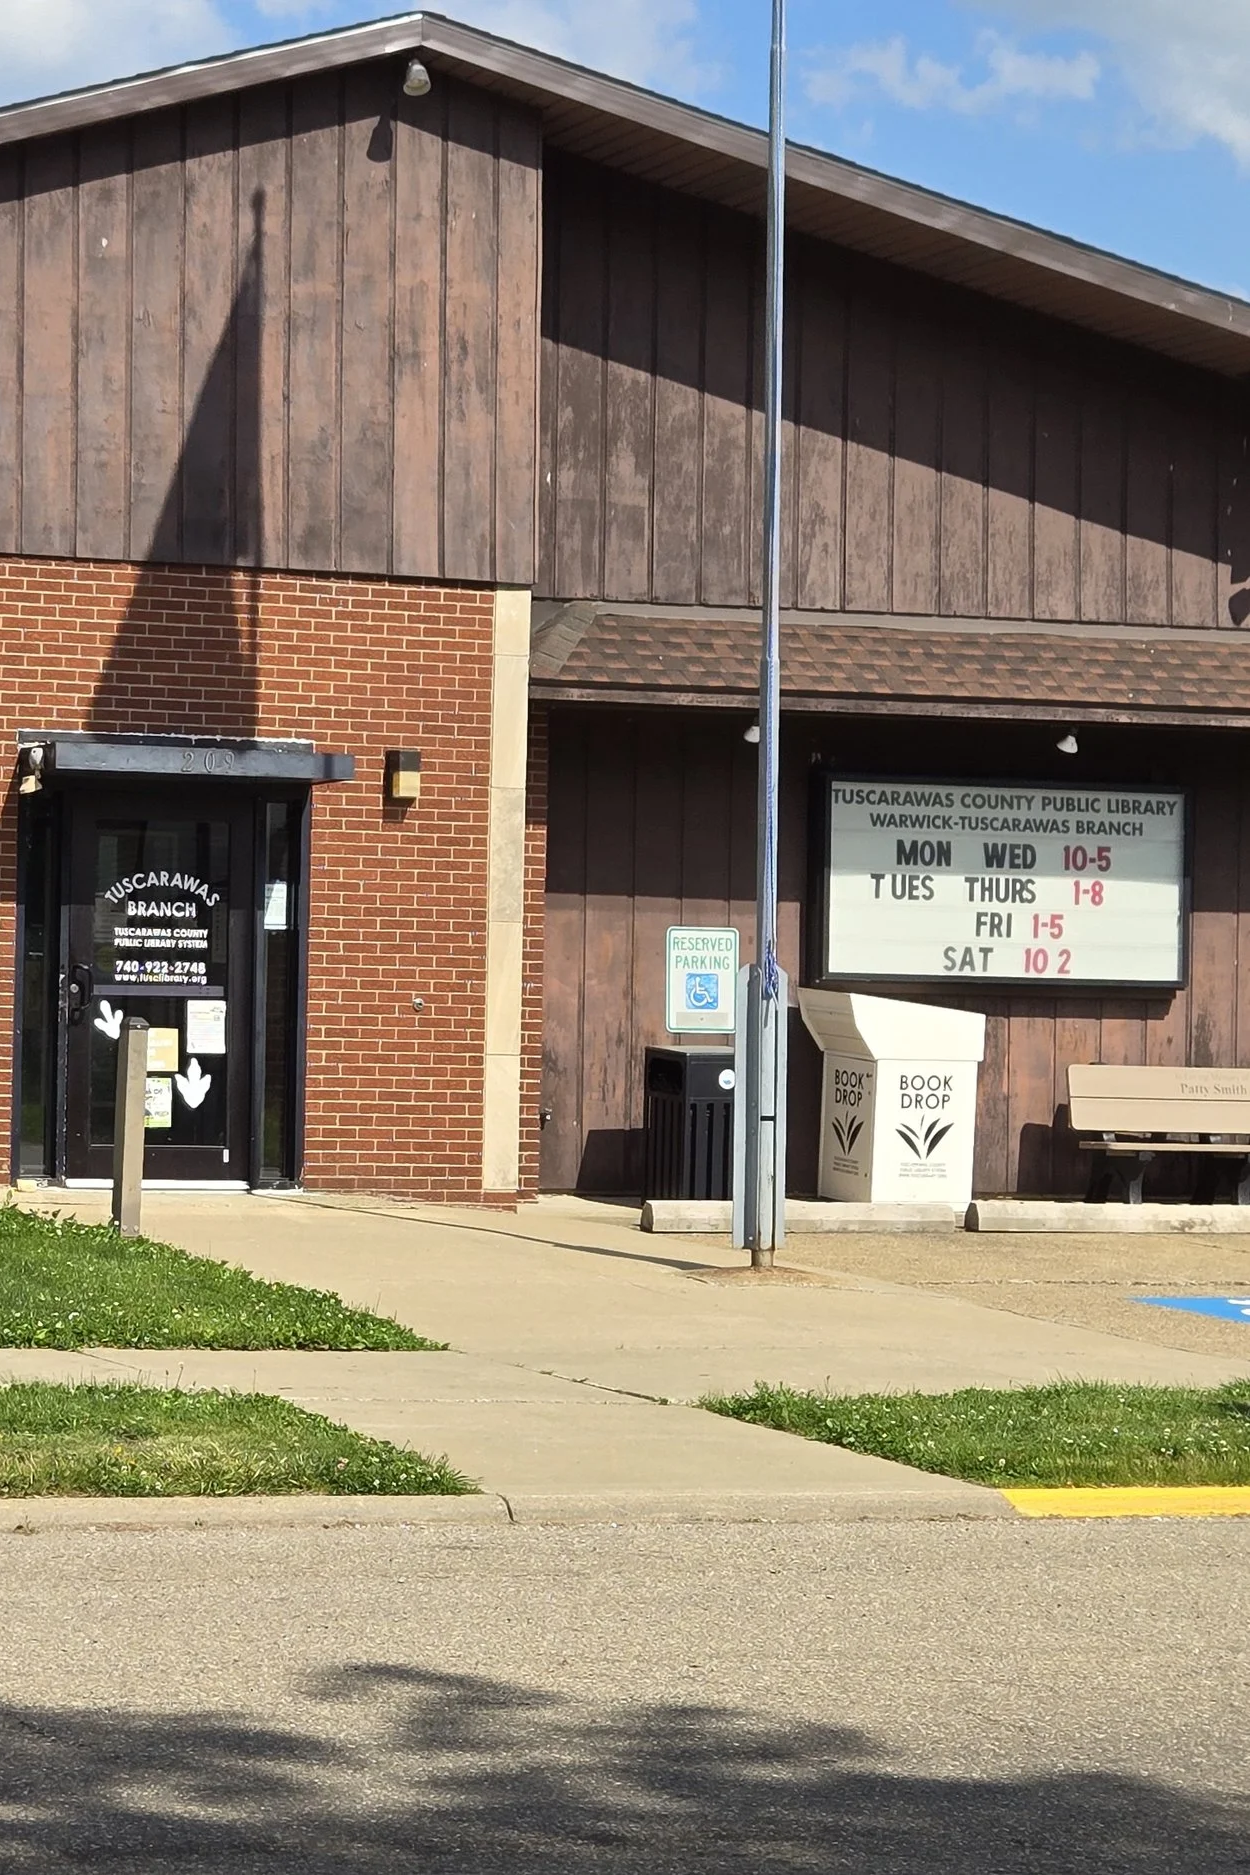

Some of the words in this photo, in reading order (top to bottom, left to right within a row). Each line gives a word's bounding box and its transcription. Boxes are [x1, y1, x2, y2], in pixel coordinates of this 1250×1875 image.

[181, 751, 235, 773] 209
[832, 788, 955, 808] TUSCARAWAS
[960, 792, 1035, 811] COUNTY
[1041, 796, 1101, 813] PUBLIC
[1107, 800, 1178, 816] LIBRARY
[869, 813, 1070, 834] WARWICK-TUSCARAWAS
[1075, 820, 1144, 837] BRANCH
[896, 839, 952, 867] MON
[983, 842, 1037, 870] WED
[1063, 845, 1112, 872] 10-5
[104, 871, 220, 907] TUSCARAWAS
[870, 873, 935, 901] TUES
[964, 876, 1037, 904] THURS
[1073, 880, 1104, 906] 1-8
[127, 900, 197, 918] BRANCH
[114, 927, 172, 937] TUSCARAWAS
[173, 929, 208, 939] COUNTY
[975, 912, 1012, 938] FRI
[1032, 914, 1064, 940] 1-5
[114, 938, 143, 948] PUBLIC
[144, 939, 176, 949] LIBRARY
[177, 940, 208, 949] SYSTEM
[672, 936, 733, 952] RESERVED
[675, 955, 730, 970] PARKING
[943, 946, 994, 973] SAT
[1024, 948, 1049, 975] 10
[1057, 949, 1071, 975] 2
[834, 1069, 865, 1090] BOOK
[899, 1074, 953, 1092] BOOK
[835, 1088, 863, 1108] DROP
[1180, 1083, 1209, 1098] Patty
[1213, 1084, 1248, 1095] Smith
[901, 1093, 951, 1110] DROP
